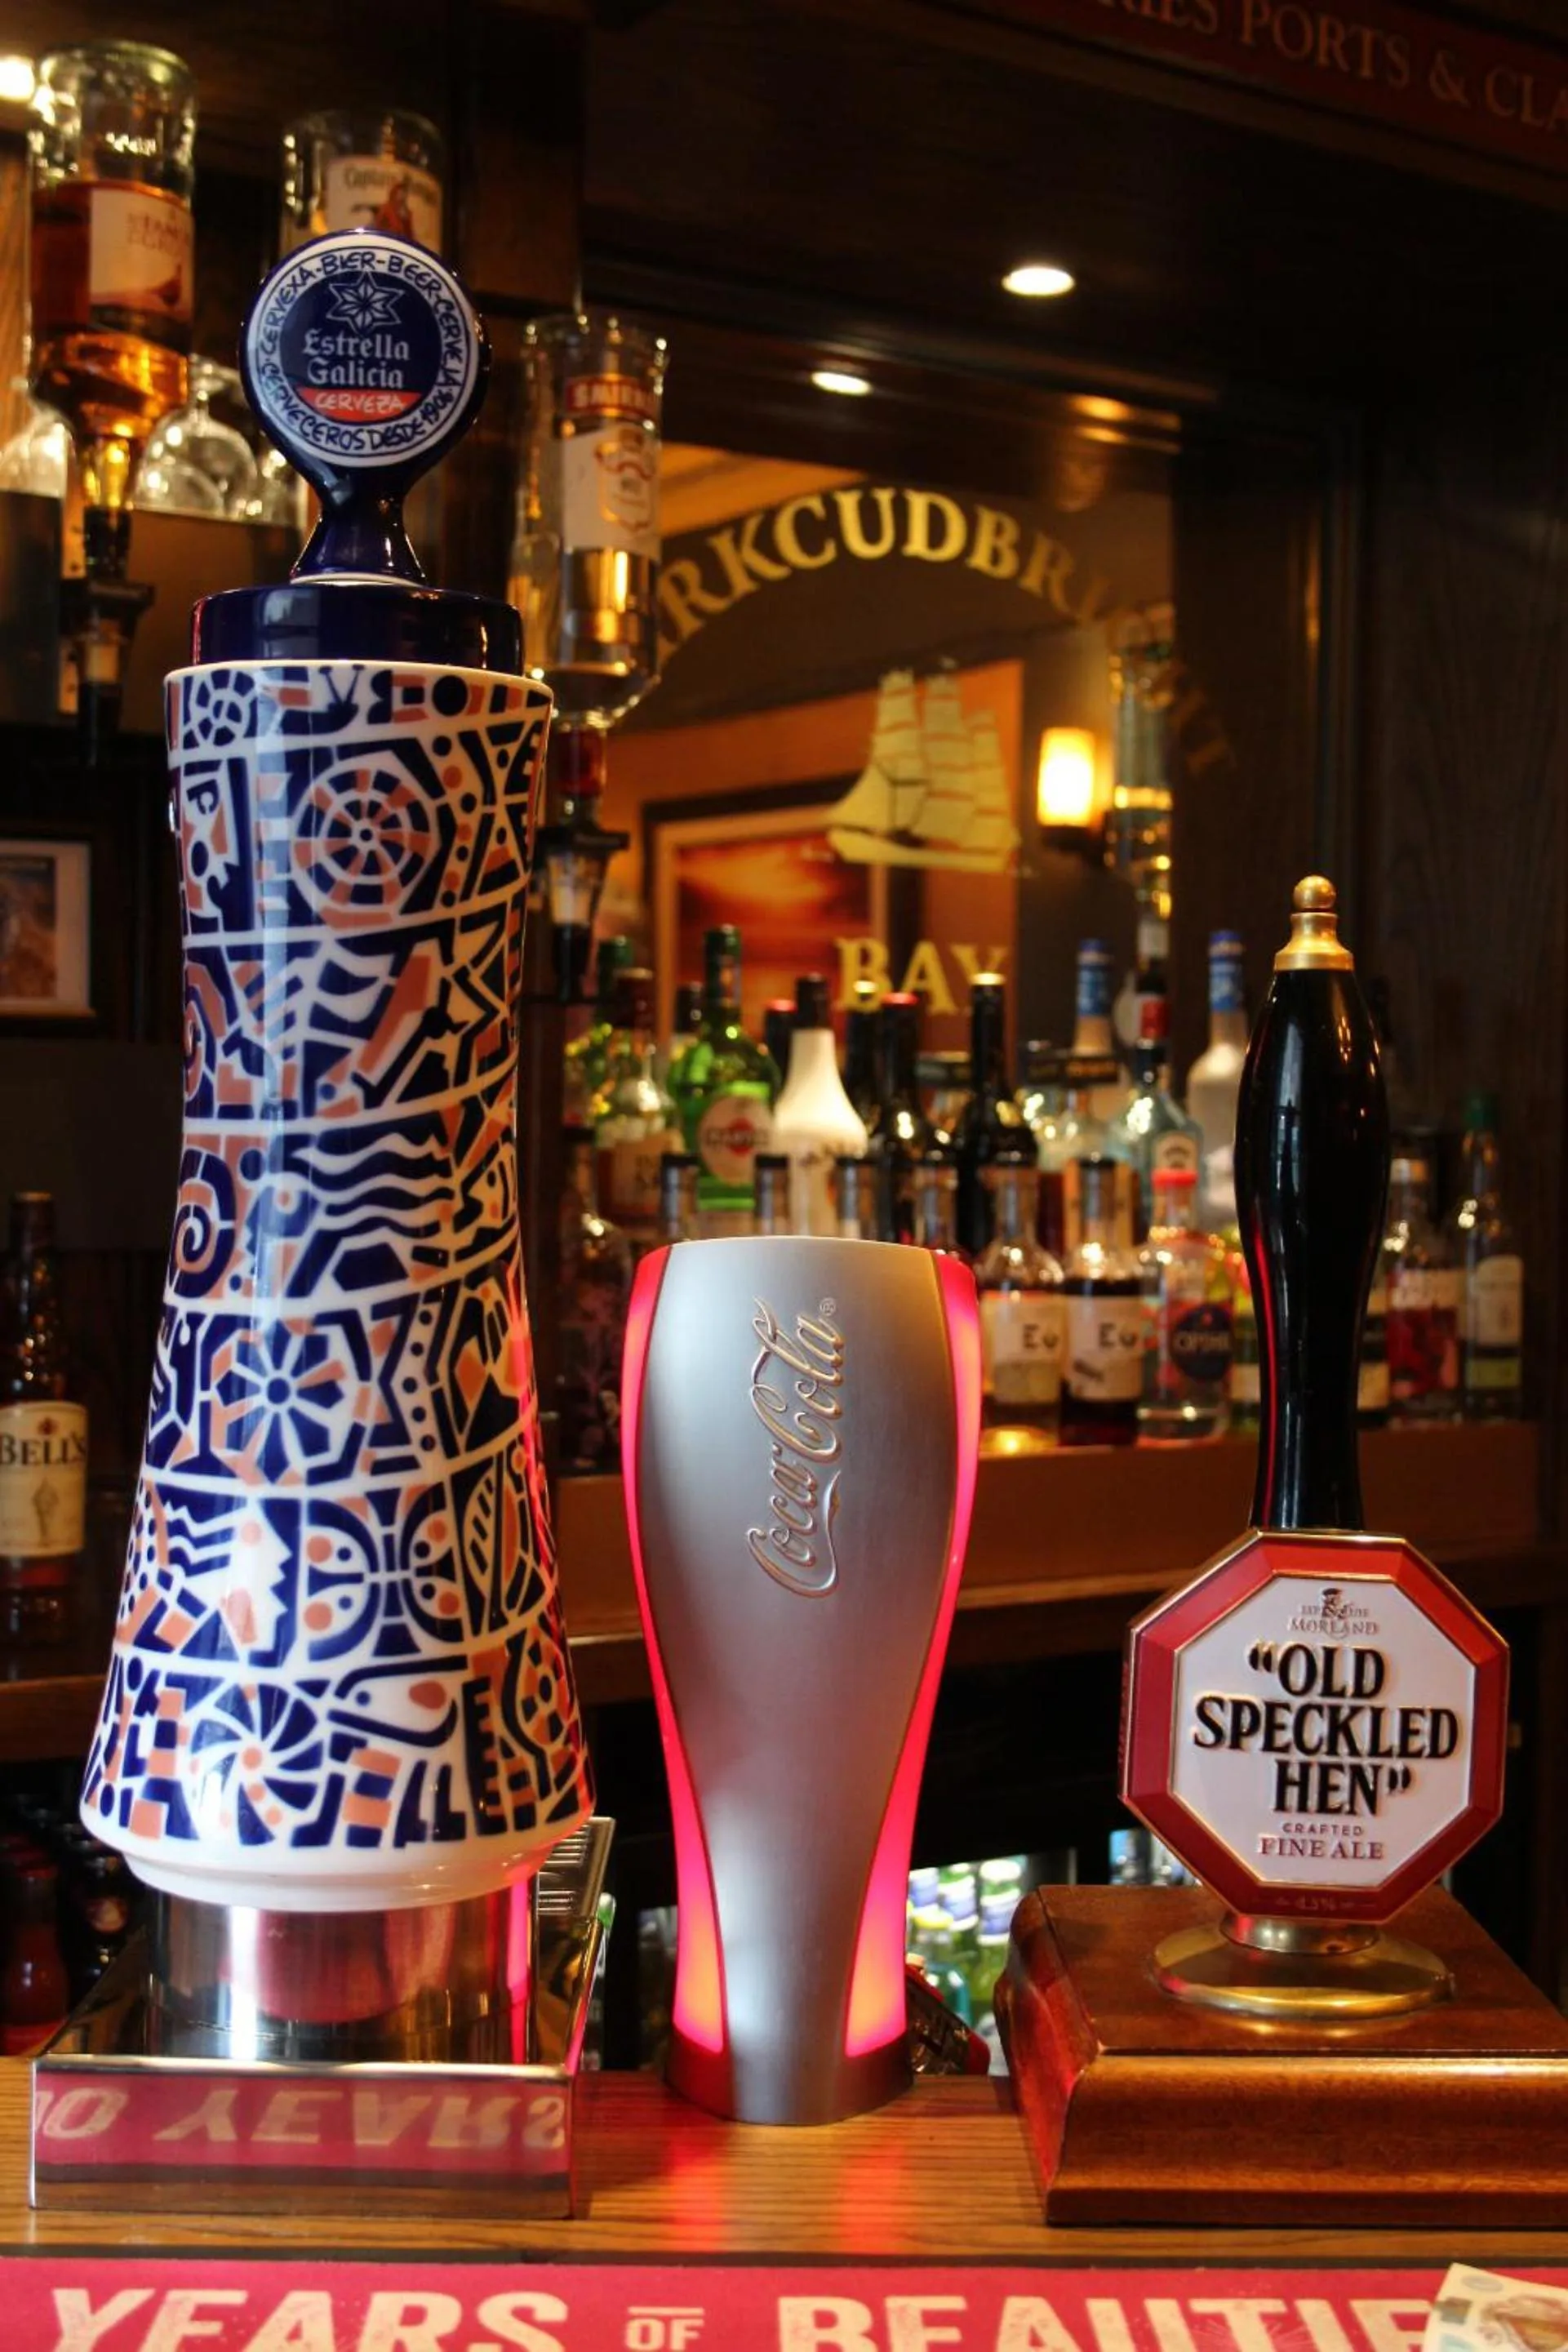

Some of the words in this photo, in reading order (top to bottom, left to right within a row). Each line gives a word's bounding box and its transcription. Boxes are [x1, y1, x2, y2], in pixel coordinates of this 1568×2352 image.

[1240, 0, 1410, 90] PORTS
[1428, 49, 1471, 109] &
[260, 267, 316, 354] CERVEXA
[321, 251, 375, 275] BIER
[388, 255, 442, 297] BEER
[432, 297, 463, 387] CERVEJA
[302, 328, 410, 361] Estrella
[308, 358, 404, 389] Galicia
[260, 360, 366, 450] CERVECEROS
[368, 419, 427, 450] DESDE
[314, 393, 406, 414] CERVEZA
[747, 1296, 846, 1598] Coca-Cola
[1289, 1617, 1380, 1635] MORLAND
[1193, 1696, 1459, 1760] SPECKLED
[1260, 1838, 1325, 1859] FINE
[1327, 1841, 1385, 1861] ALE
[1281, 1822, 1366, 1837] CRAFTED
[51, 2288, 570, 2352] YEARS
[625, 2319, 704, 2352] OF
